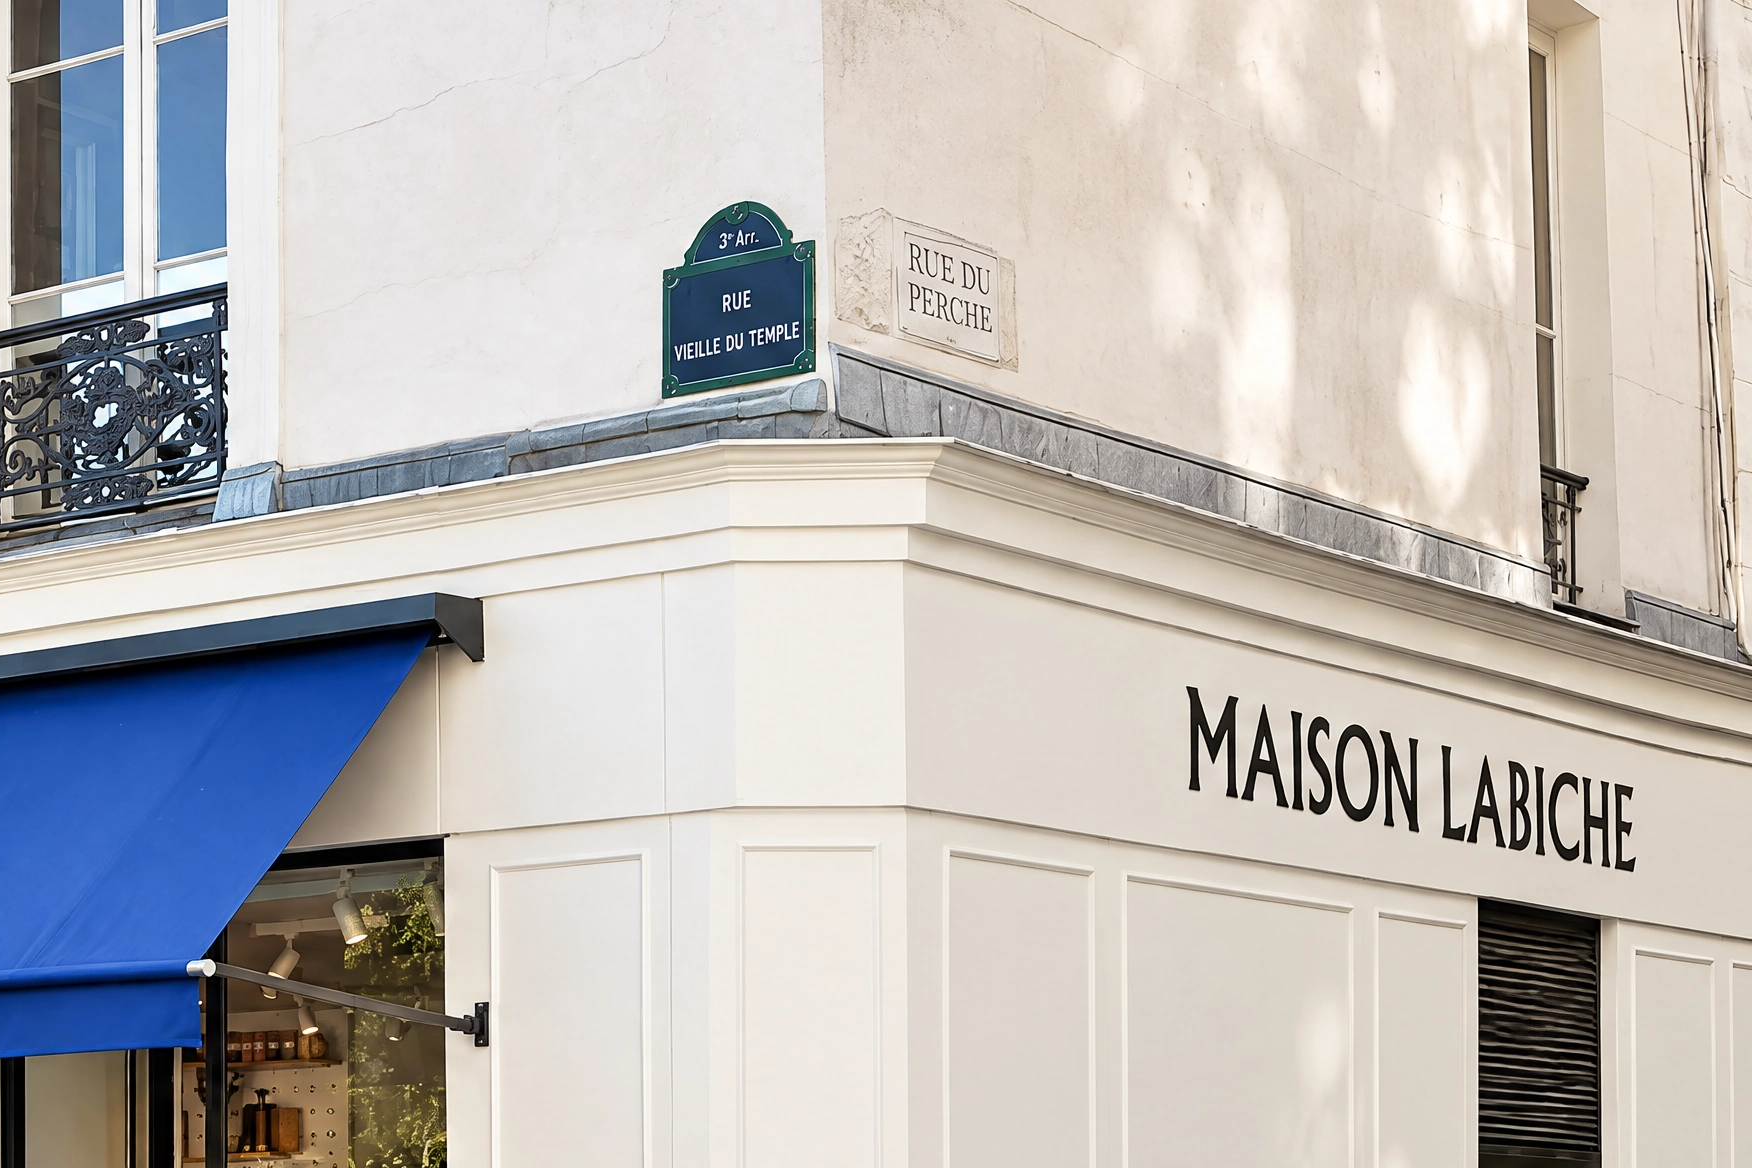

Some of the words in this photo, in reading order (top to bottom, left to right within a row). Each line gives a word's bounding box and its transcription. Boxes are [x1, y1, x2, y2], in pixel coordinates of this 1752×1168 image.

[909, 242, 955, 286] RUE
[961, 260, 992, 296] DU
[722, 289, 752, 313] RUE
[909, 282, 993, 334] PERCHE
[674, 337, 721, 362] VIEILLE
[726, 332, 744, 352] DU
[748, 321, 800, 347] TEMPLE
[1185, 685, 1420, 834] MAISON
[1441, 744, 1638, 873] LABICHE
